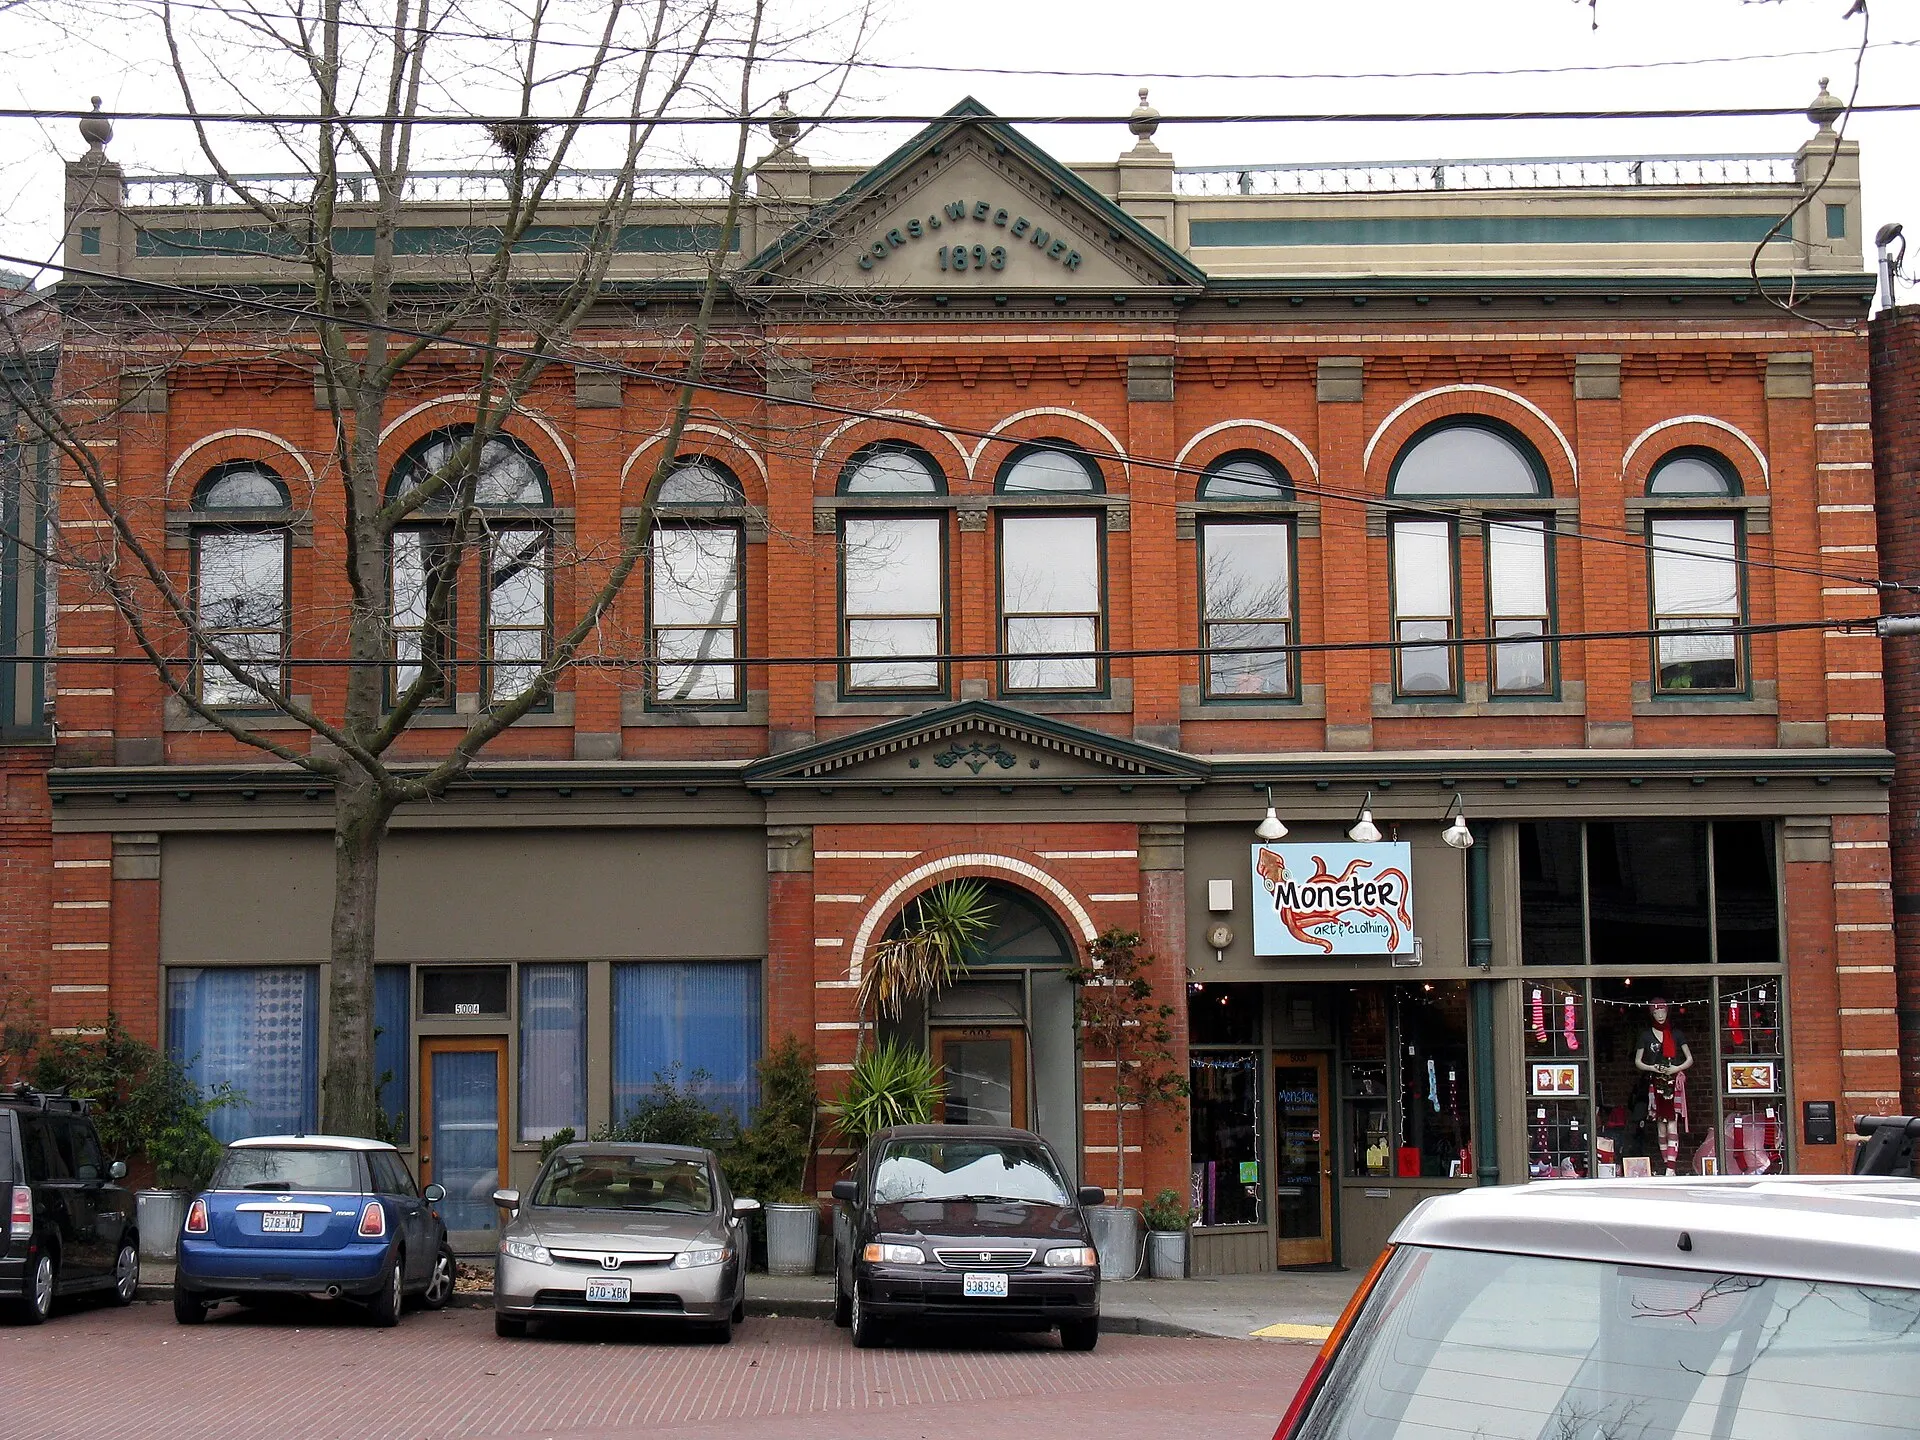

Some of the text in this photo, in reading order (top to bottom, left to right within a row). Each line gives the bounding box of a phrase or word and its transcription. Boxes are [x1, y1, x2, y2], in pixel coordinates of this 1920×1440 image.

[858, 199, 1083, 272] CORS & WEGENER
[938, 244, 1007, 271] 1893
[1338, 922, 1344, 937] &
[455, 1004, 480, 1014] 5004
[966, 1280, 995, 1292] 93839
